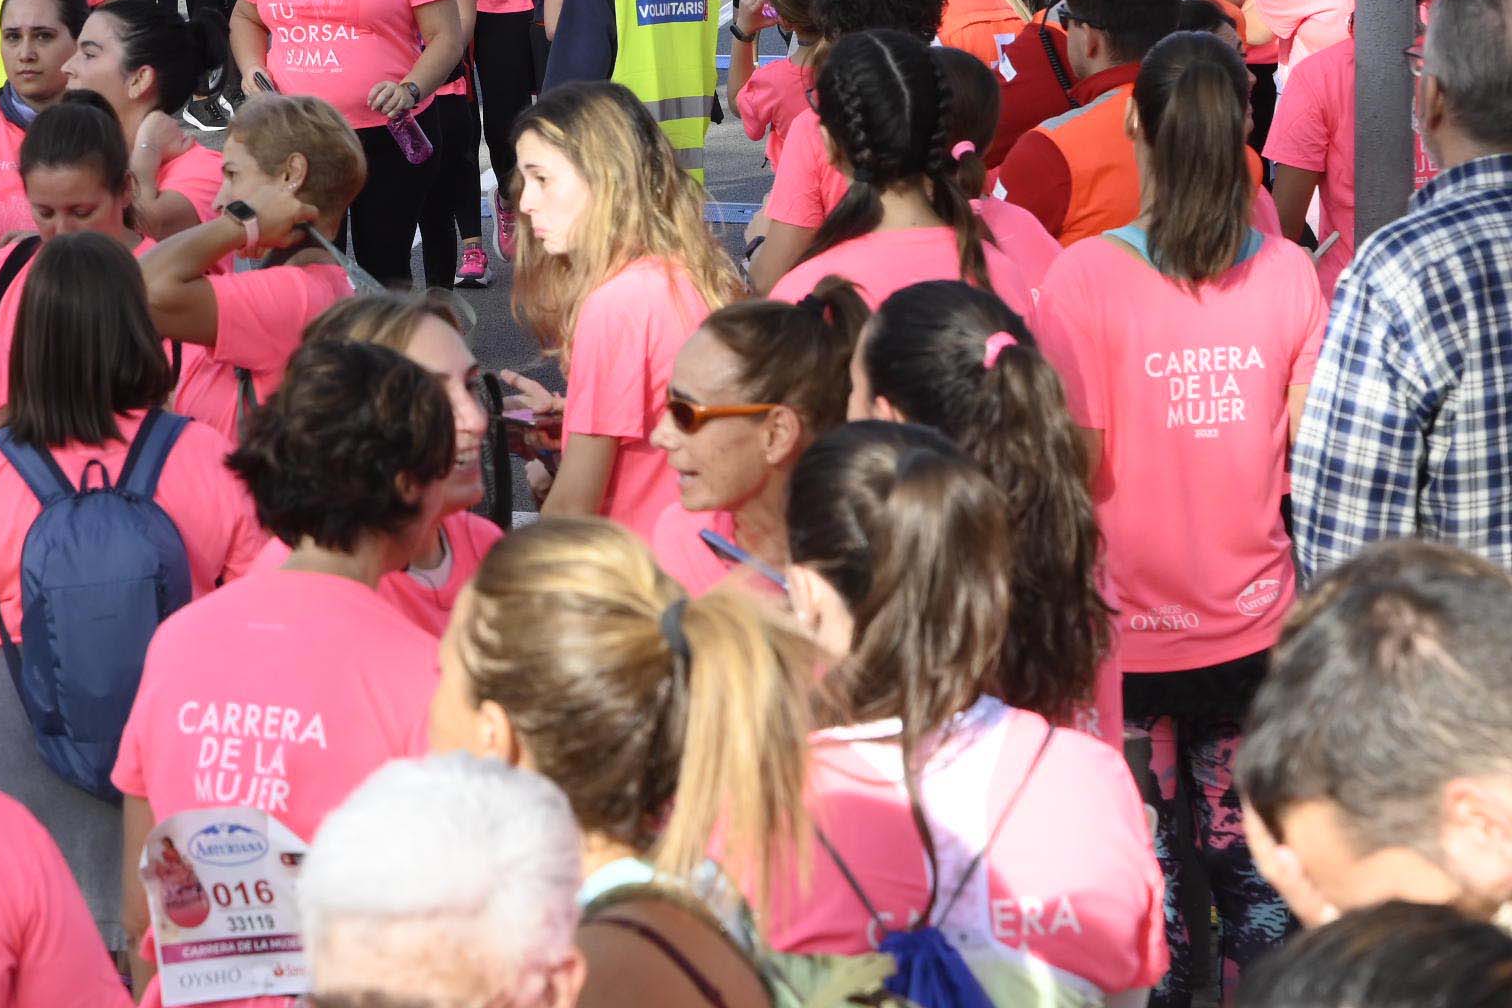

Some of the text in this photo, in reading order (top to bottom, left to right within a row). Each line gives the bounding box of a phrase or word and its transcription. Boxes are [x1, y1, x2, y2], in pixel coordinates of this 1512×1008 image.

[268, 1, 294, 20] TU
[638, 0, 705, 19] VOLUNTARIS
[276, 24, 360, 43] DORSAL
[1144, 345, 1266, 378] CARRERA
[1168, 373, 1241, 401] DE LA
[1165, 397, 1246, 429] MUJER
[1130, 612, 1201, 631] OYSHO
[176, 699, 328, 749] CARRERA
[197, 737, 287, 775] DE LA
[193, 769, 292, 814] MUJER
[195, 841, 264, 858] ASTURIANA
[212, 878, 275, 907] 016
[226, 914, 276, 932] 33119
[179, 966, 243, 989] OYSHO
